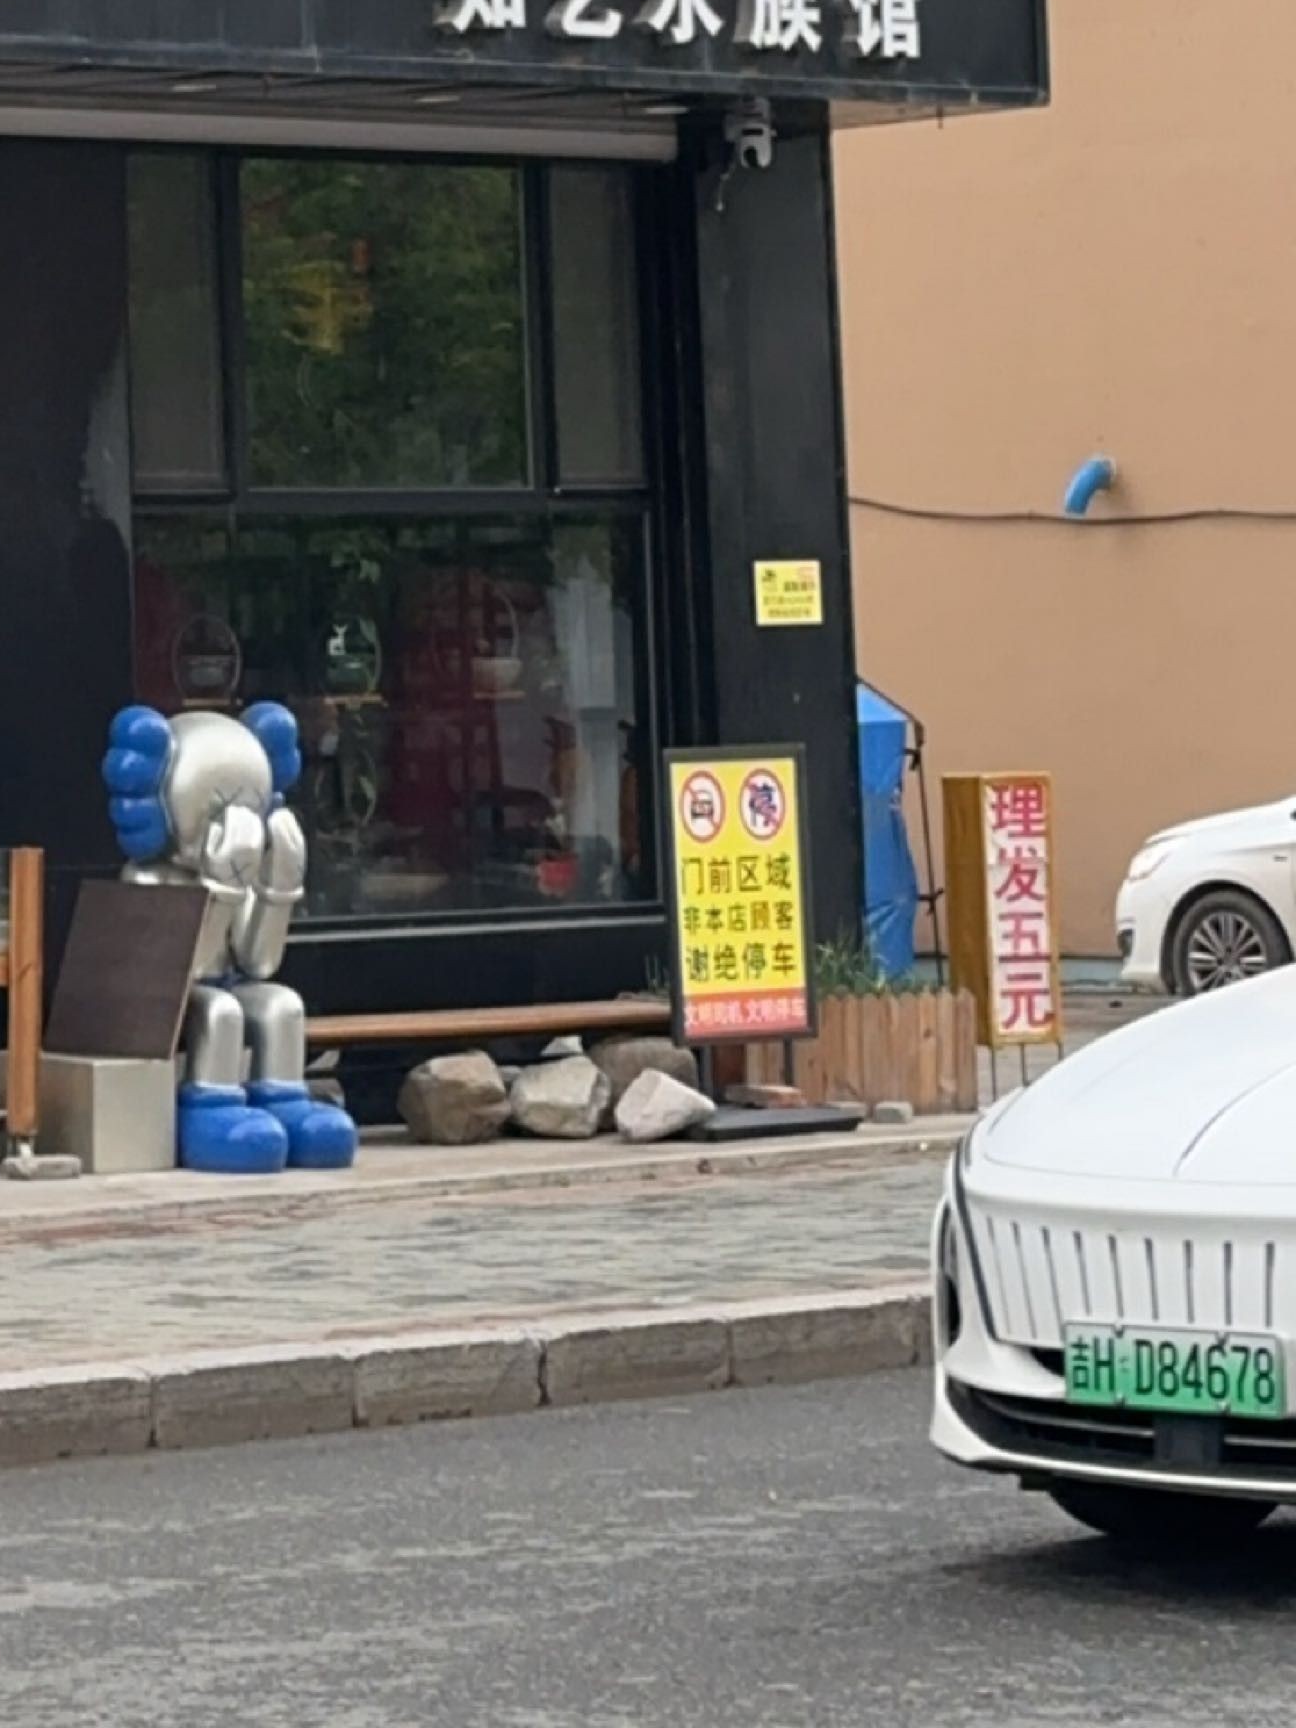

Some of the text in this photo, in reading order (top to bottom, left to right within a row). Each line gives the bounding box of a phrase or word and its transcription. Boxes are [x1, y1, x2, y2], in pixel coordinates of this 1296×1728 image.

[682, 853, 791, 895] 门前区域
[684, 901, 793, 934] 非本店顾客
[991, 783, 1052, 1030] 理发五元
[686, 942, 796, 982] 谢绝停车
